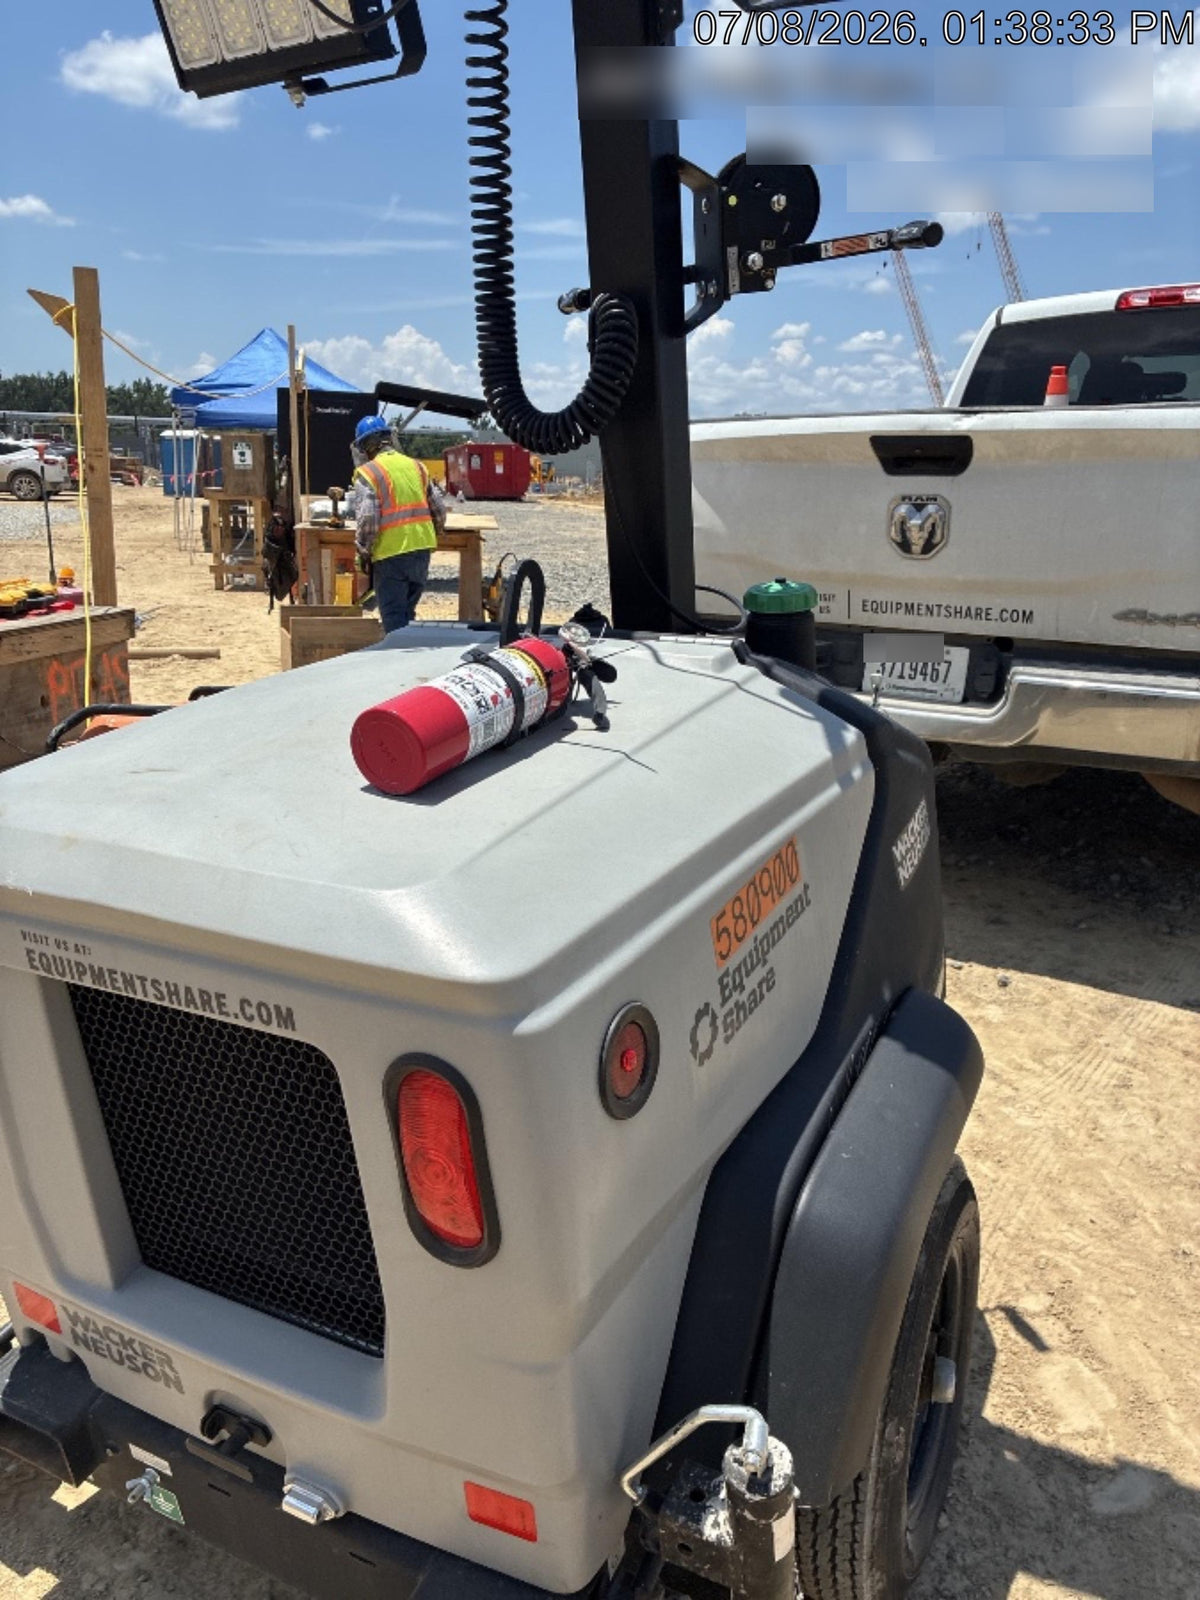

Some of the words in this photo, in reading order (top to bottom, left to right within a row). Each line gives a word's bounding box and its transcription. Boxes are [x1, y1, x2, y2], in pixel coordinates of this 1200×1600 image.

[861, 599, 1034, 625] EQUIPMENTSHARE.COM
[715, 839, 800, 961] 580900
[21, 930, 50, 946] VISIT
[54, 937, 69, 951] US
[74, 943, 91, 955] AT:
[718, 882, 812, 1008] Equipment
[25, 948, 297, 1031] EQUIPMENTSHARE.COM
[722, 966, 777, 1044] Share
[60, 1305, 180, 1374] WACKER
[70, 1327, 185, 1395] NEUSON
